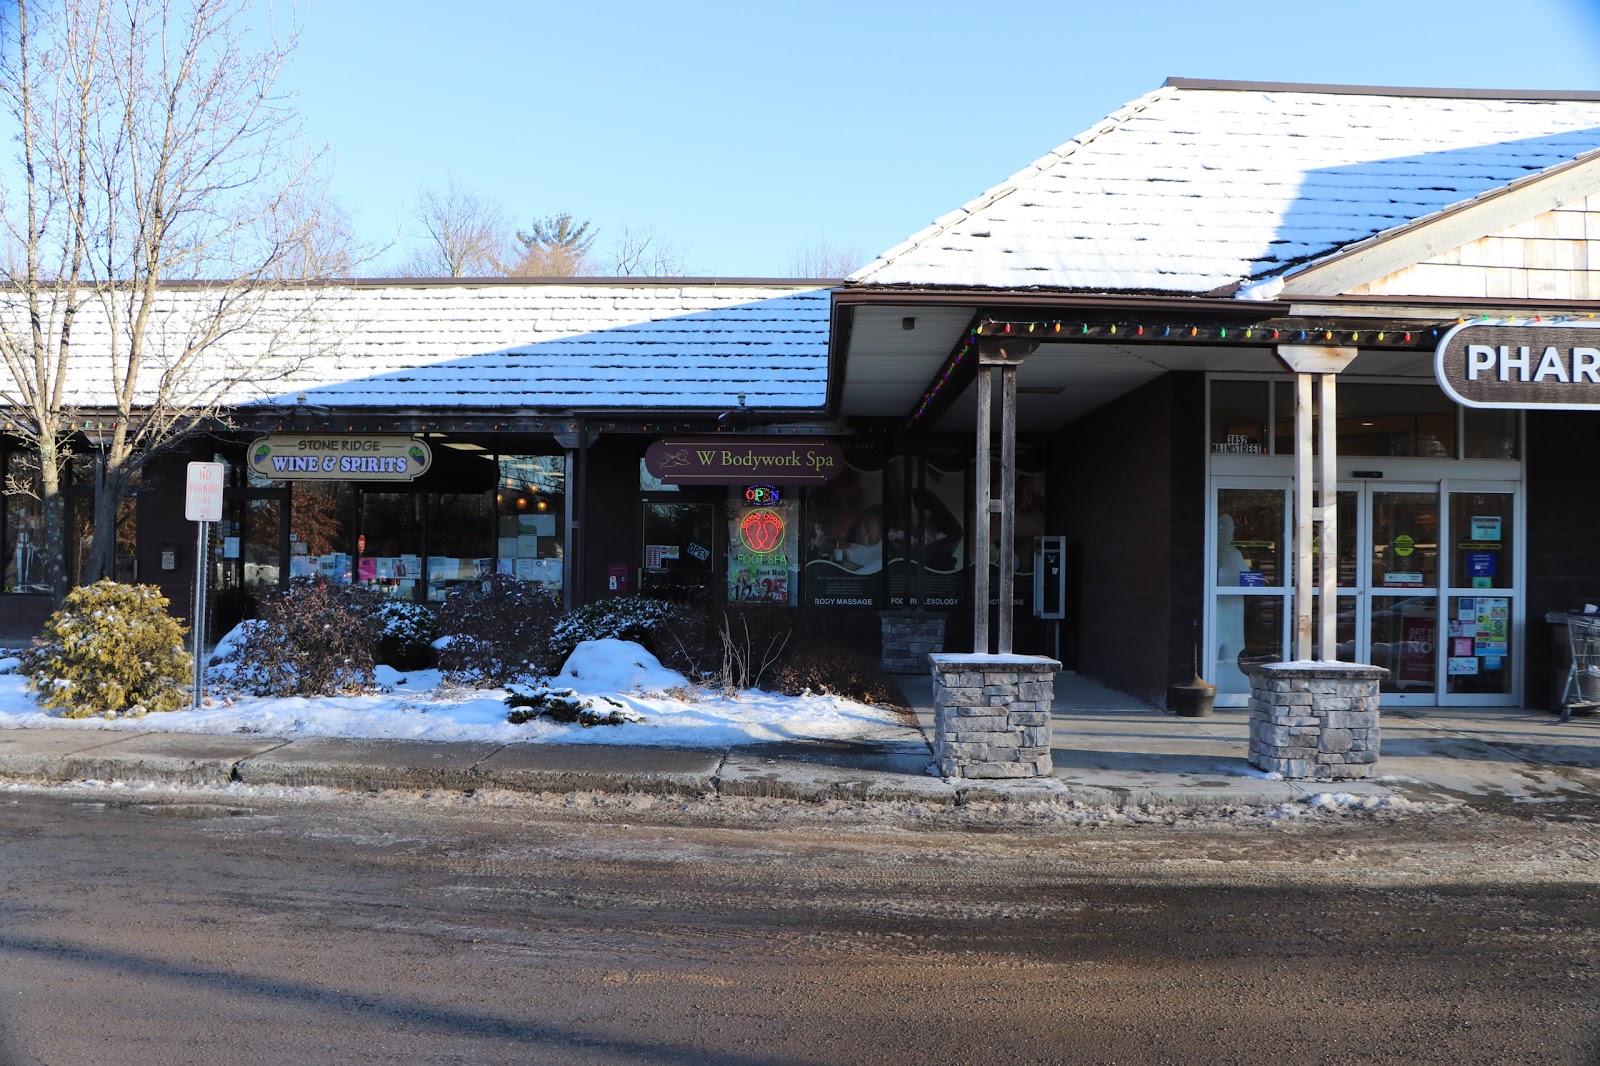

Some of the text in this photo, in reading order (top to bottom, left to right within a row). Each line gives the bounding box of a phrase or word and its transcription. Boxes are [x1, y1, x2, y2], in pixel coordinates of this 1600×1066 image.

[298, 439, 381, 451] STONE RIDGE
[1228, 435, 1248, 444] 3852
[1211, 443, 1262, 454] MAIN STREET
[271, 455, 408, 473] WINE & SPIRITS
[696, 449, 834, 471] W Bodywork Spa
[199, 469, 212, 480] NO
[190, 482, 220, 494] PARKING
[745, 488, 780, 501] OPEN
[197, 496, 212, 505] FIRE
[195, 506, 211, 515] LANE
[688, 544, 709, 560] OPEN
[737, 554, 788, 565] FOOT SPA
[1409, 627, 1425, 635] GET
[1408, 641, 1436, 654] NO
